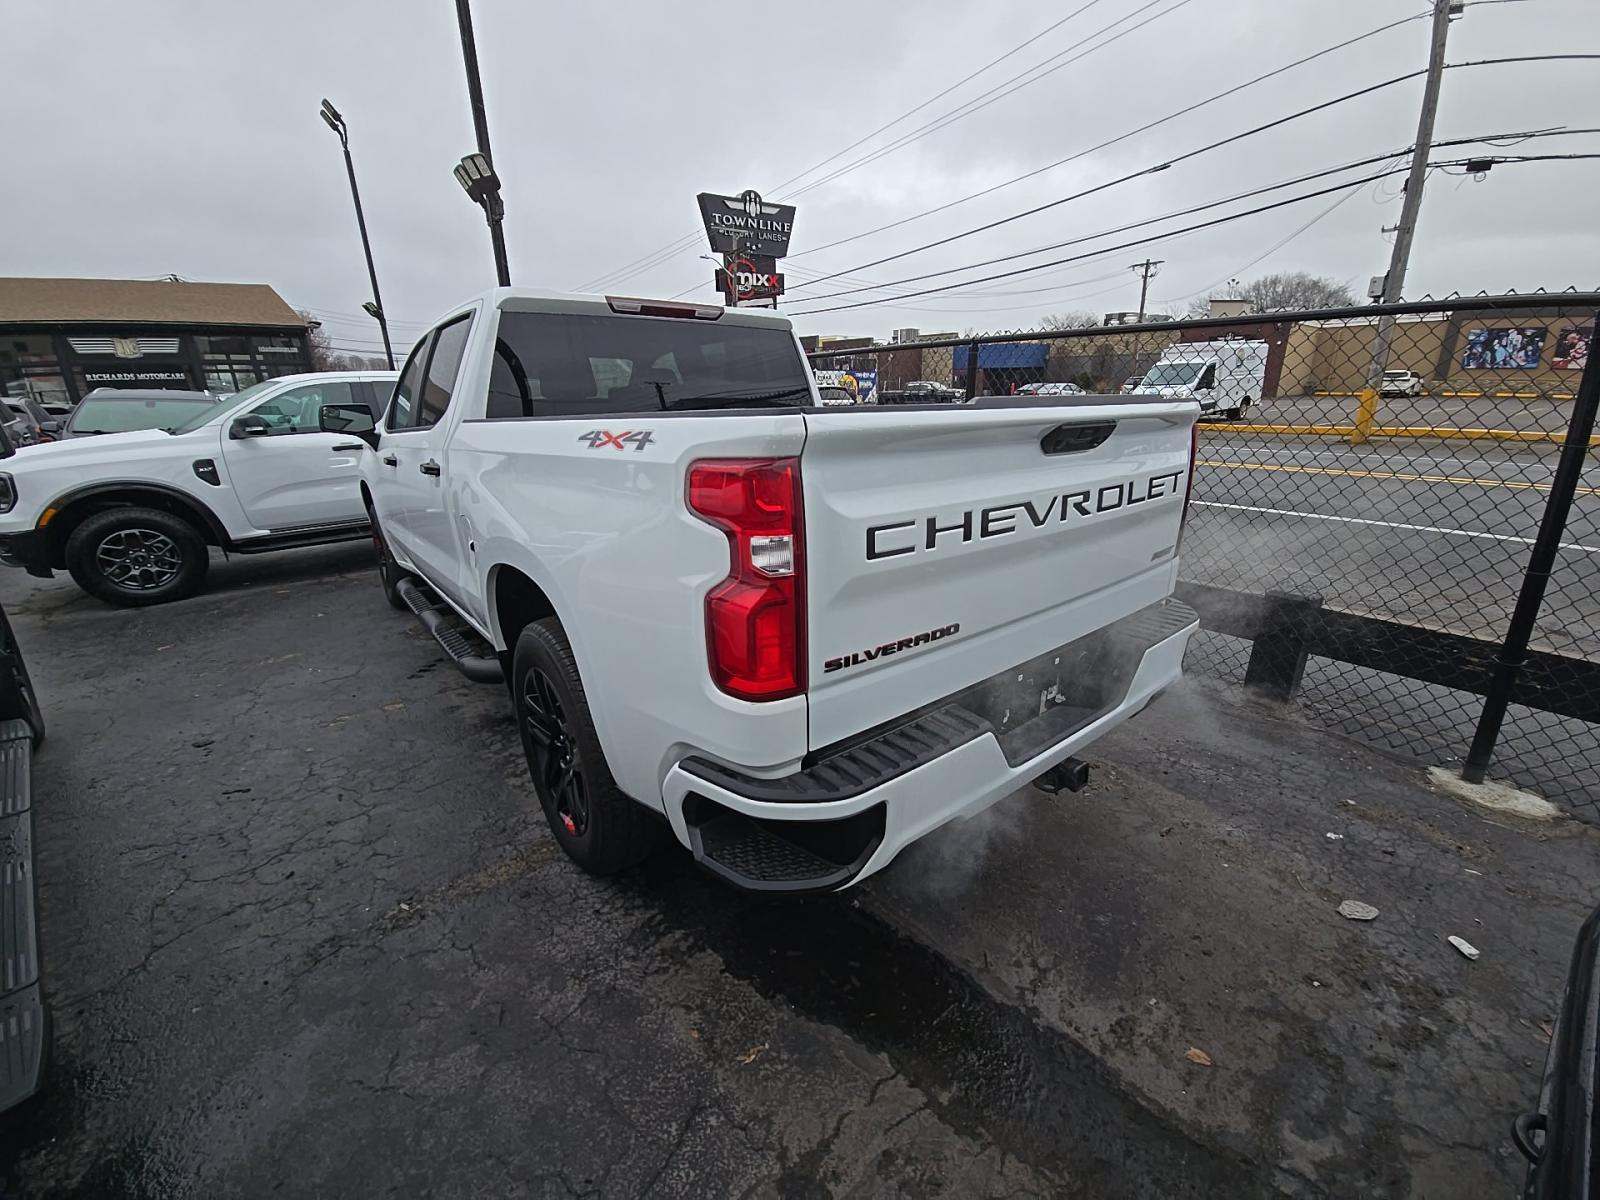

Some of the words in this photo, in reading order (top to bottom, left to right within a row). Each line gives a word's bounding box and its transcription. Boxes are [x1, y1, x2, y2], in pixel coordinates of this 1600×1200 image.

[712, 213, 791, 233] TOWNLINE
[758, 231, 782, 242] LANES
[85, 373, 136, 381] RICHARDS
[136, 372, 185, 380] MOTORCARS
[866, 470, 1185, 561] CHEVROLET
[824, 622, 961, 674] SILVERADO
